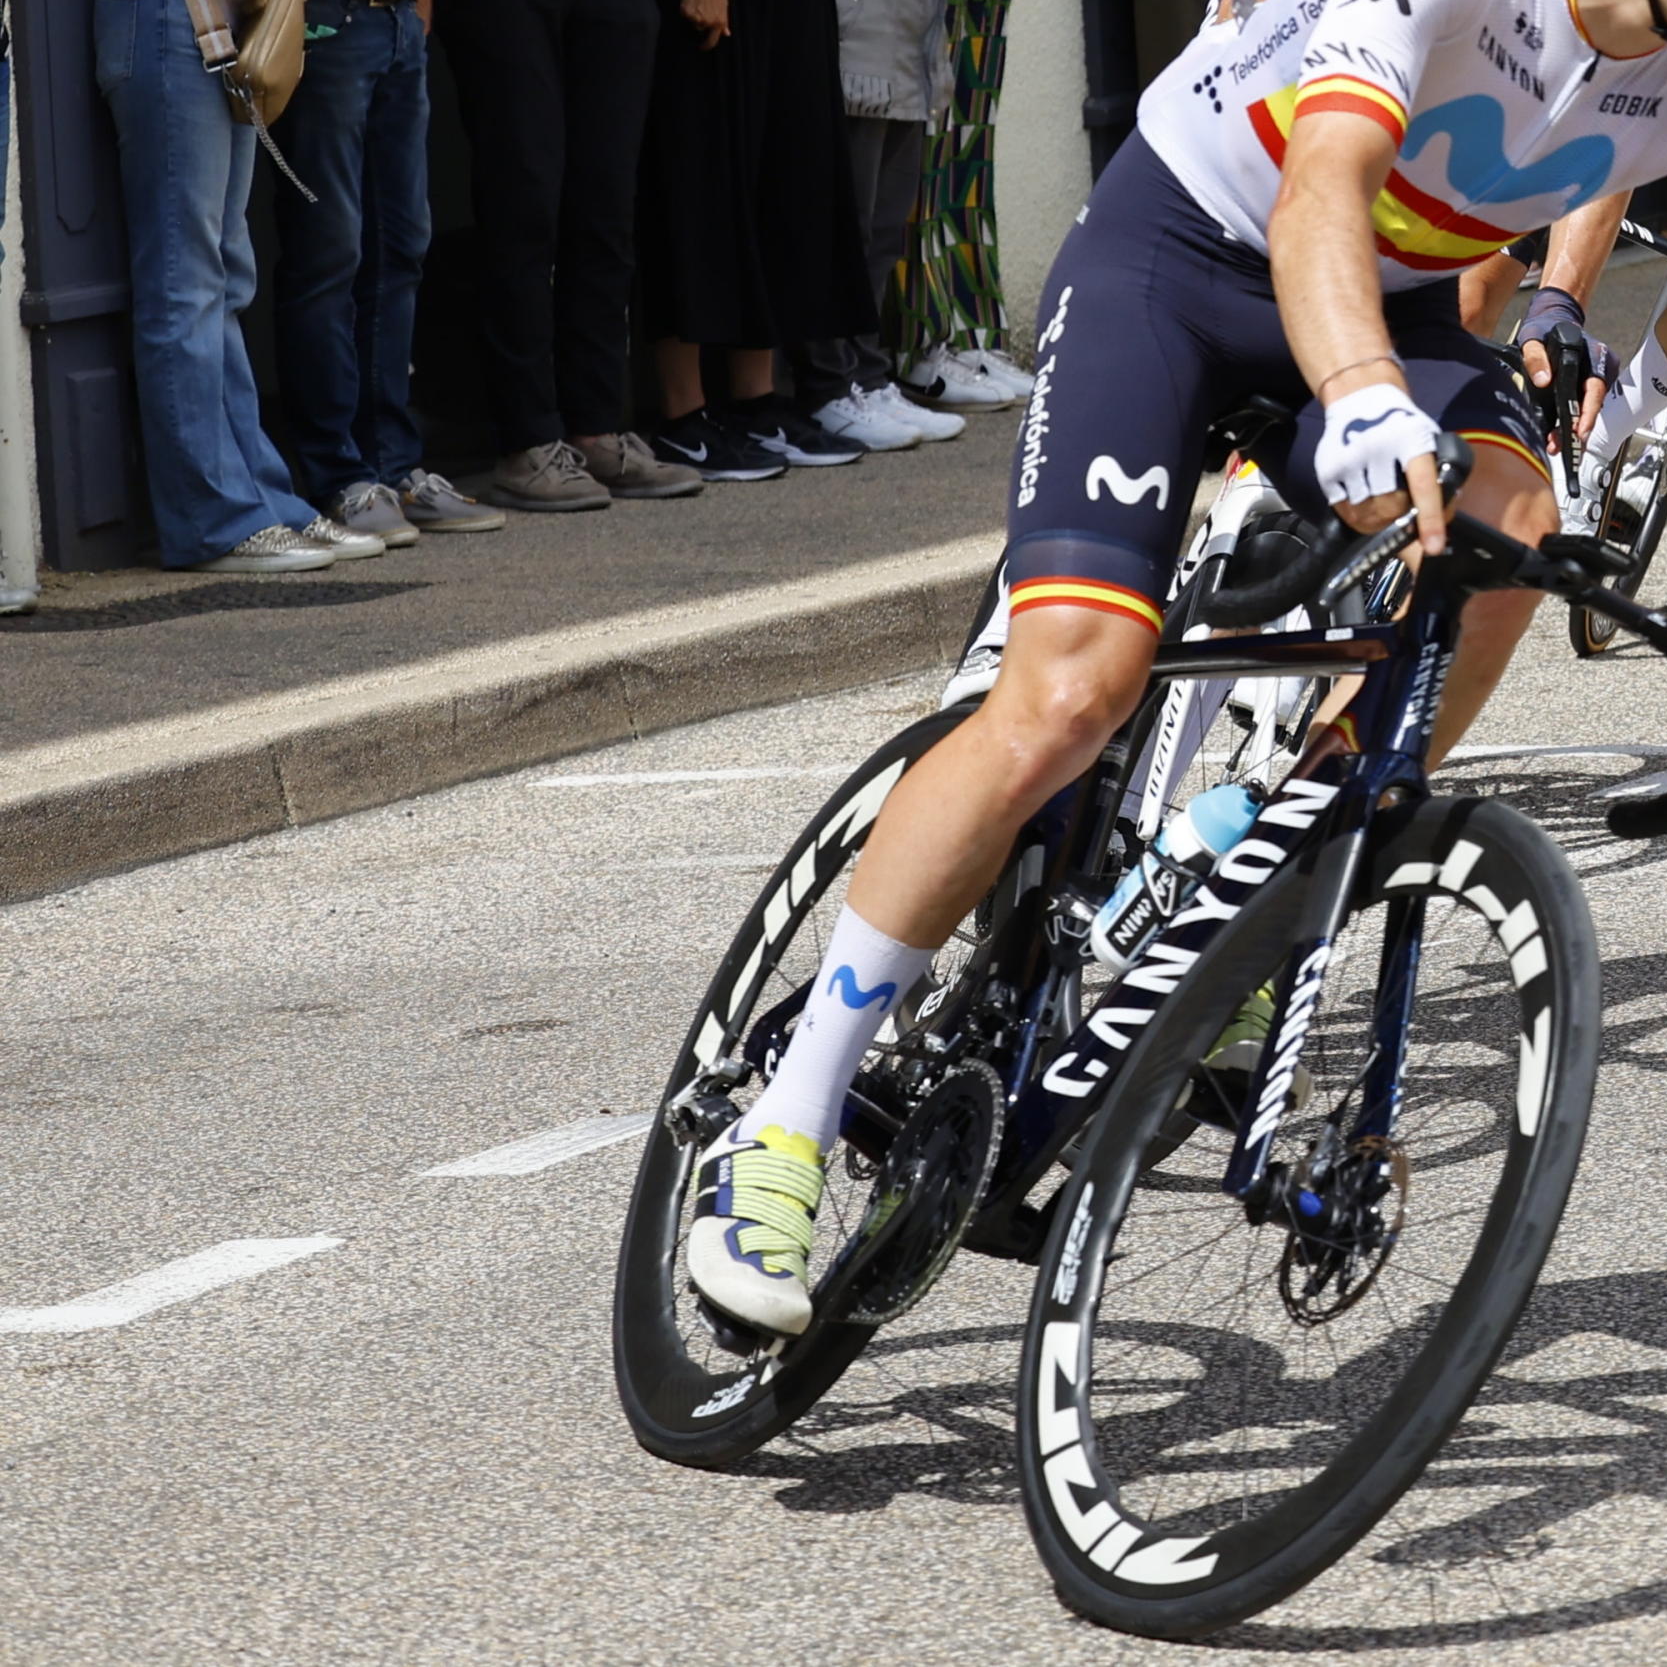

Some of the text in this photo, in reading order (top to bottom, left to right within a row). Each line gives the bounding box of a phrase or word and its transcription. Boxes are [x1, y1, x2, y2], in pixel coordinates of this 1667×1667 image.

[1227, 15, 1300, 86] Telefónica
[1476, 25, 1546, 104] CANYON
[1598, 92, 1663, 119] GOBIK
[1016, 352, 1057, 509] Telefónica
[1042, 777, 1342, 1100] CANYON
[1241, 943, 1336, 1149] CANYON
